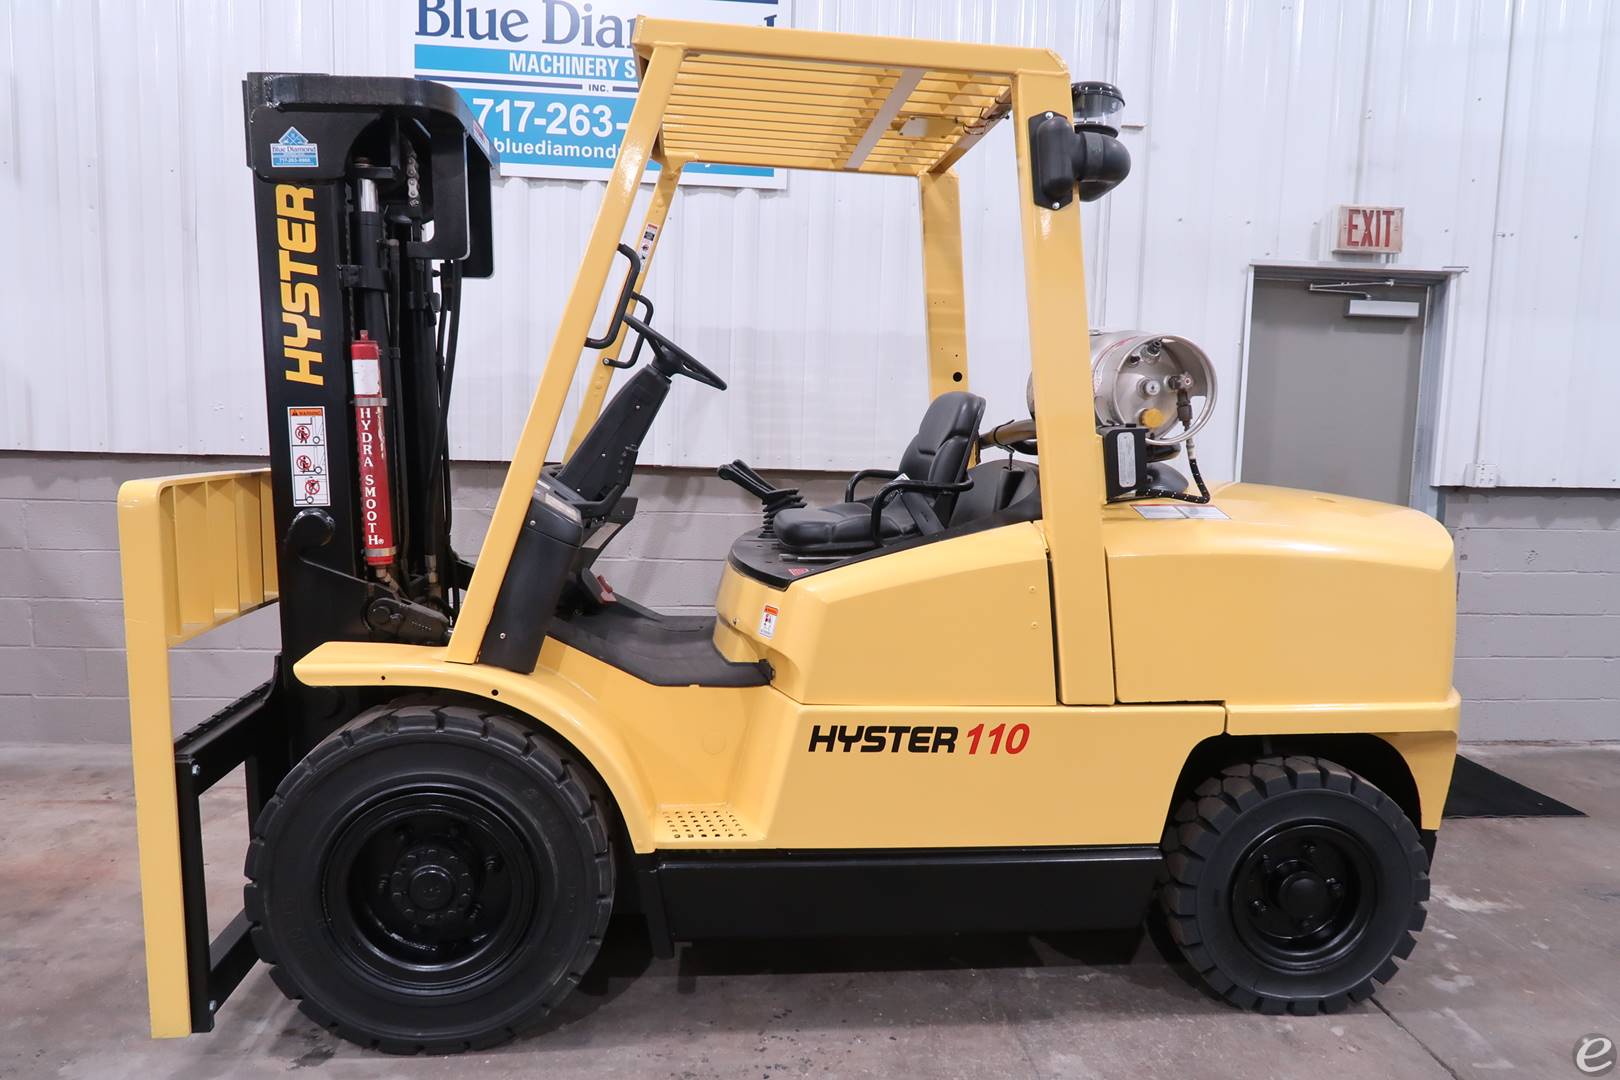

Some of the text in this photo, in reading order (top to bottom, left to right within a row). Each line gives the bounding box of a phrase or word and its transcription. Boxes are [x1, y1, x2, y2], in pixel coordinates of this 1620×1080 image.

[415, 0, 529, 43] Blue
[509, 52, 620, 79] MACHINERY
[588, 83, 609, 93] INC.
[494, 137, 621, 160] bluediamond
[1347, 208, 1395, 248] EXIT
[275, 184, 324, 386] HYSTER
[360, 407, 374, 468] HYDRA
[808, 723, 1031, 755] HYSTER 110
